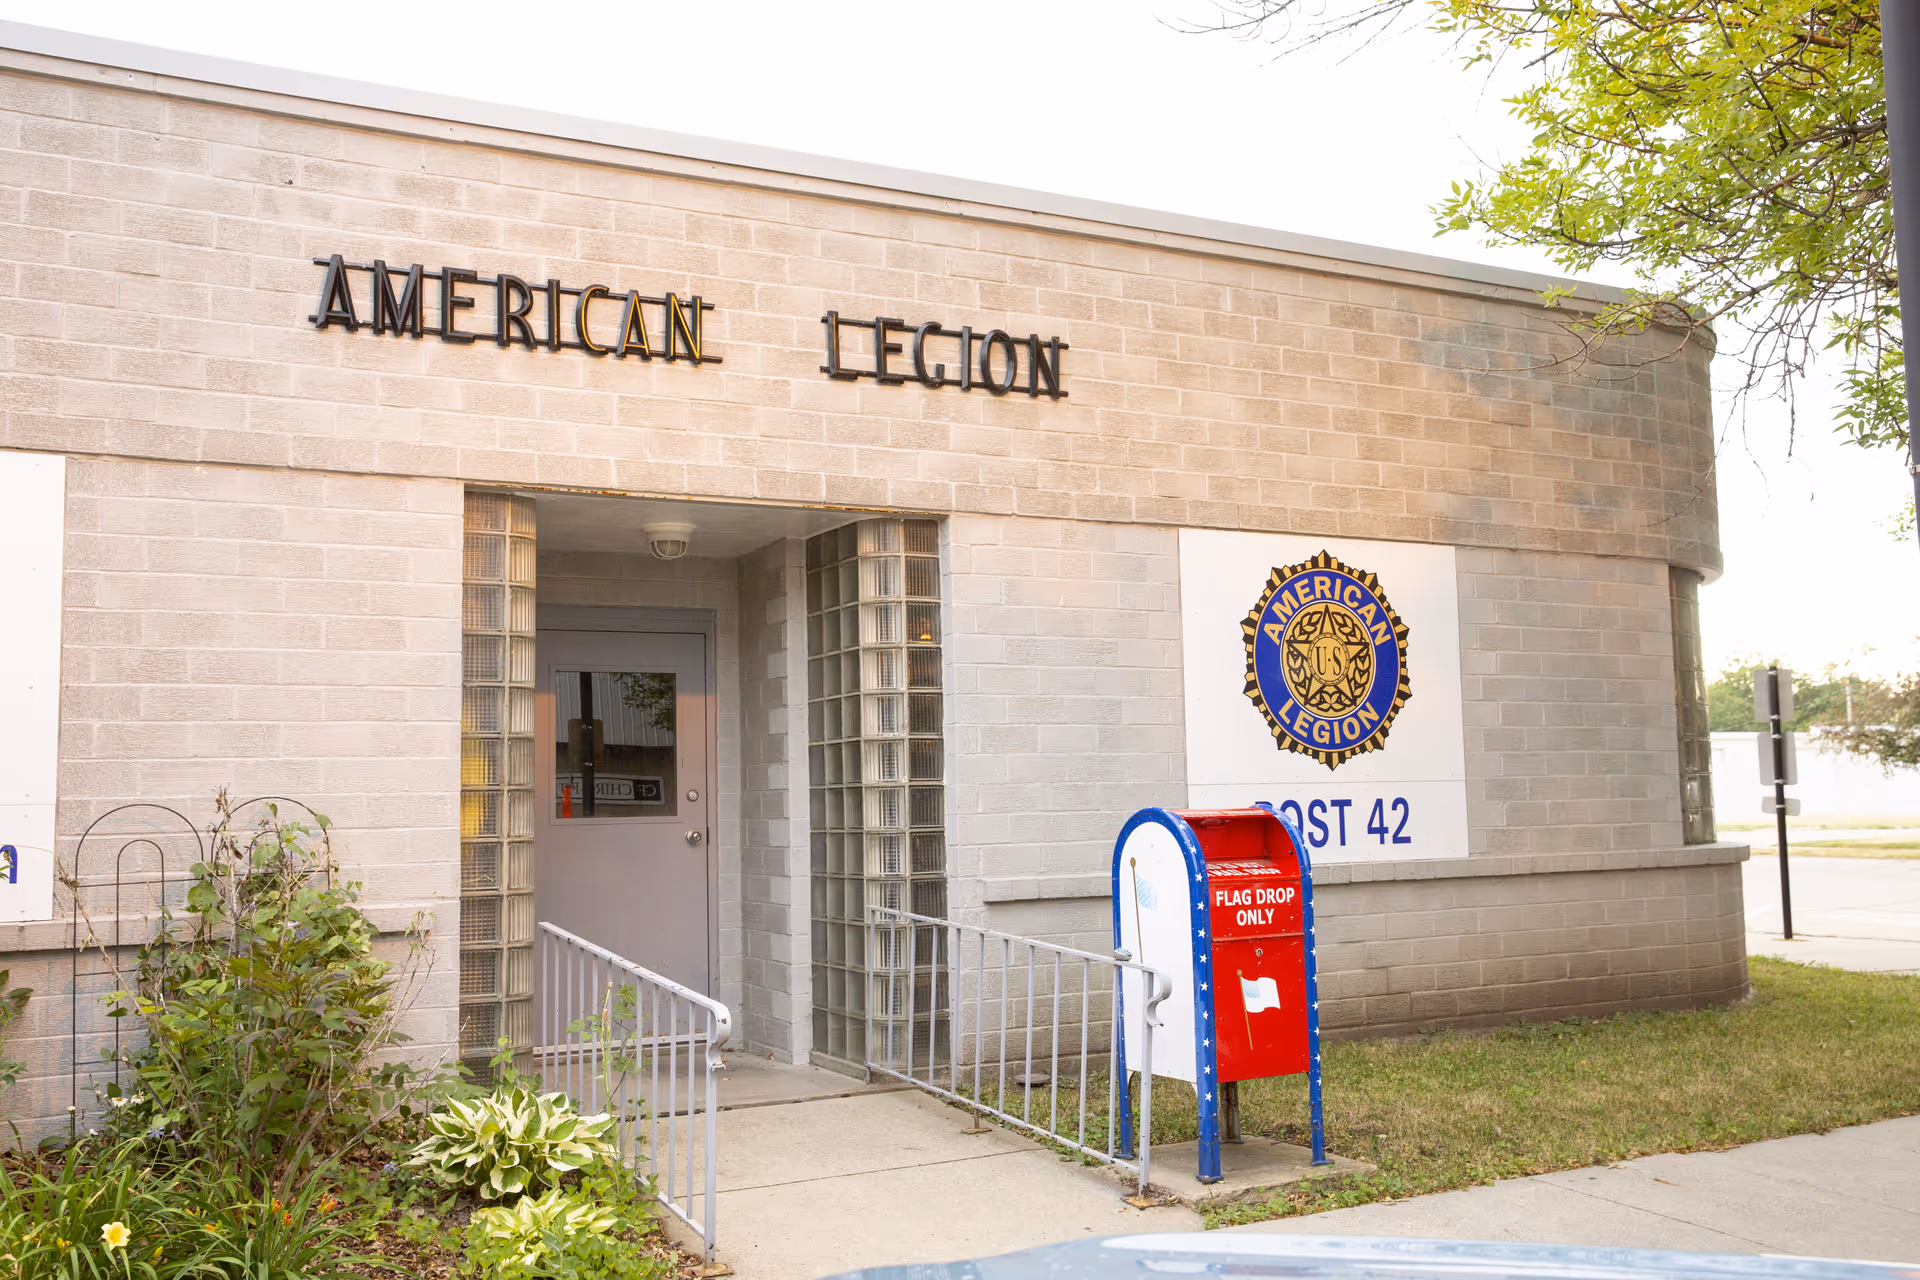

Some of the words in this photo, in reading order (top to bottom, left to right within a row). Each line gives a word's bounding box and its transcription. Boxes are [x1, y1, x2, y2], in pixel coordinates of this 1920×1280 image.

[314, 254, 704, 364] AMERICAN
[826, 310, 1061, 400] LEGION
[1263, 576, 1392, 646] AMERICAN
[1278, 698, 1380, 745] LEGION
[1255, 799, 1353, 849] OST
[1367, 797, 1412, 845] 42
[1215, 889, 1251, 907] FLAG
[1256, 887, 1295, 905] DROP
[1236, 908, 1275, 926] ONLY
